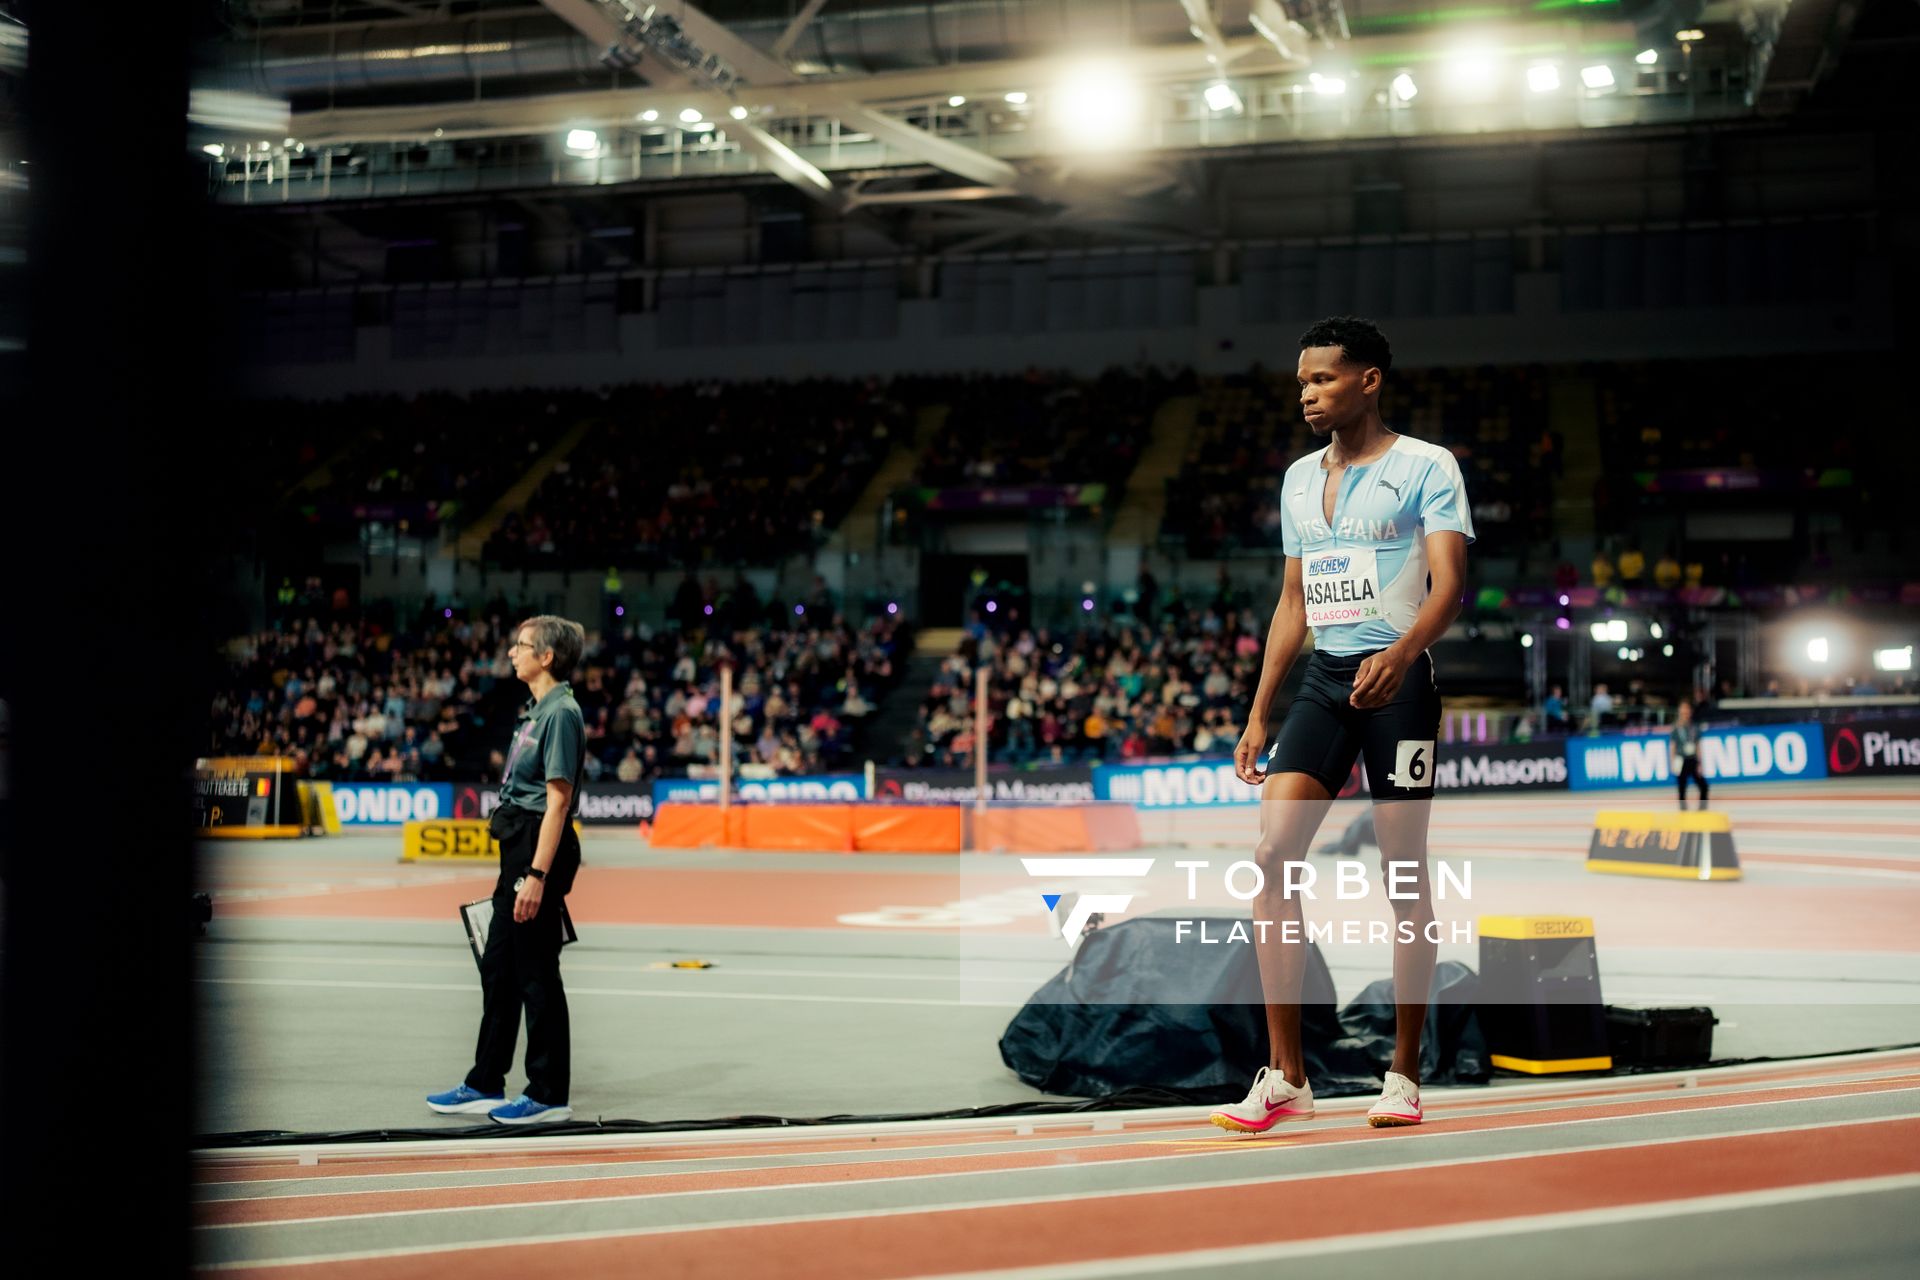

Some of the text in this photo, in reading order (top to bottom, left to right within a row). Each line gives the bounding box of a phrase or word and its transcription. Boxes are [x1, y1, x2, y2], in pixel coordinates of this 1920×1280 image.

[1305, 578, 1375, 606] ASALELA
[1311, 607, 1378, 622] GLASGOW 24
[1409, 747, 1426, 781] 6
[1620, 731, 1808, 783] MNDO
[1863, 731, 1920, 768] Pins
[1142, 765, 1262, 806] MON
[1460, 755, 1568, 787] Masons
[333, 788, 438, 822] ONDO
[420, 825, 503, 856] SEI
[1534, 921, 1584, 935] SEIKO
